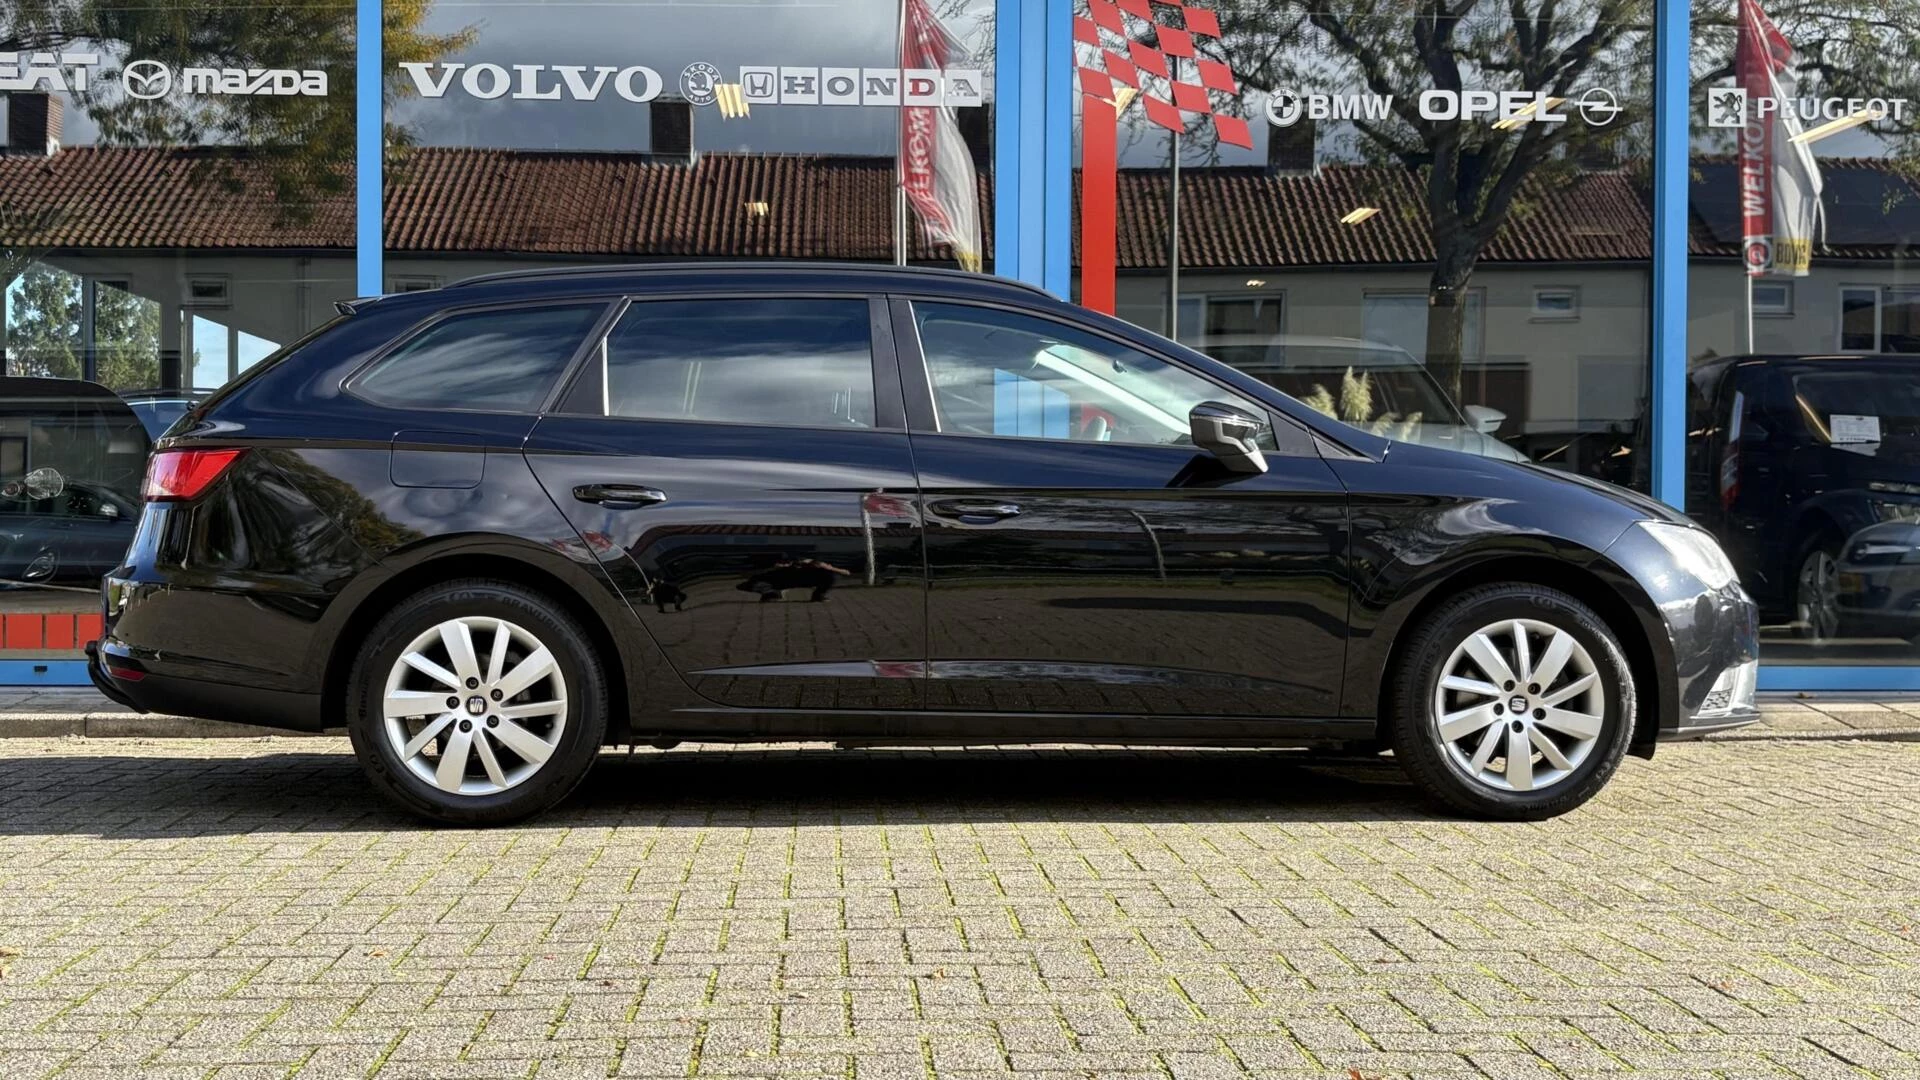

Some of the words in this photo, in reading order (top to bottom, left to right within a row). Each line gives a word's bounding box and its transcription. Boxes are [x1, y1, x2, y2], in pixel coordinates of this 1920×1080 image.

[398, 62, 663, 103] VOLVO
[783, 75, 979, 98] HONDA
[1308, 93, 1394, 121] BMW
[1418, 89, 1568, 122] OPEL
[1756, 96, 1908, 122] PEUGEOT
